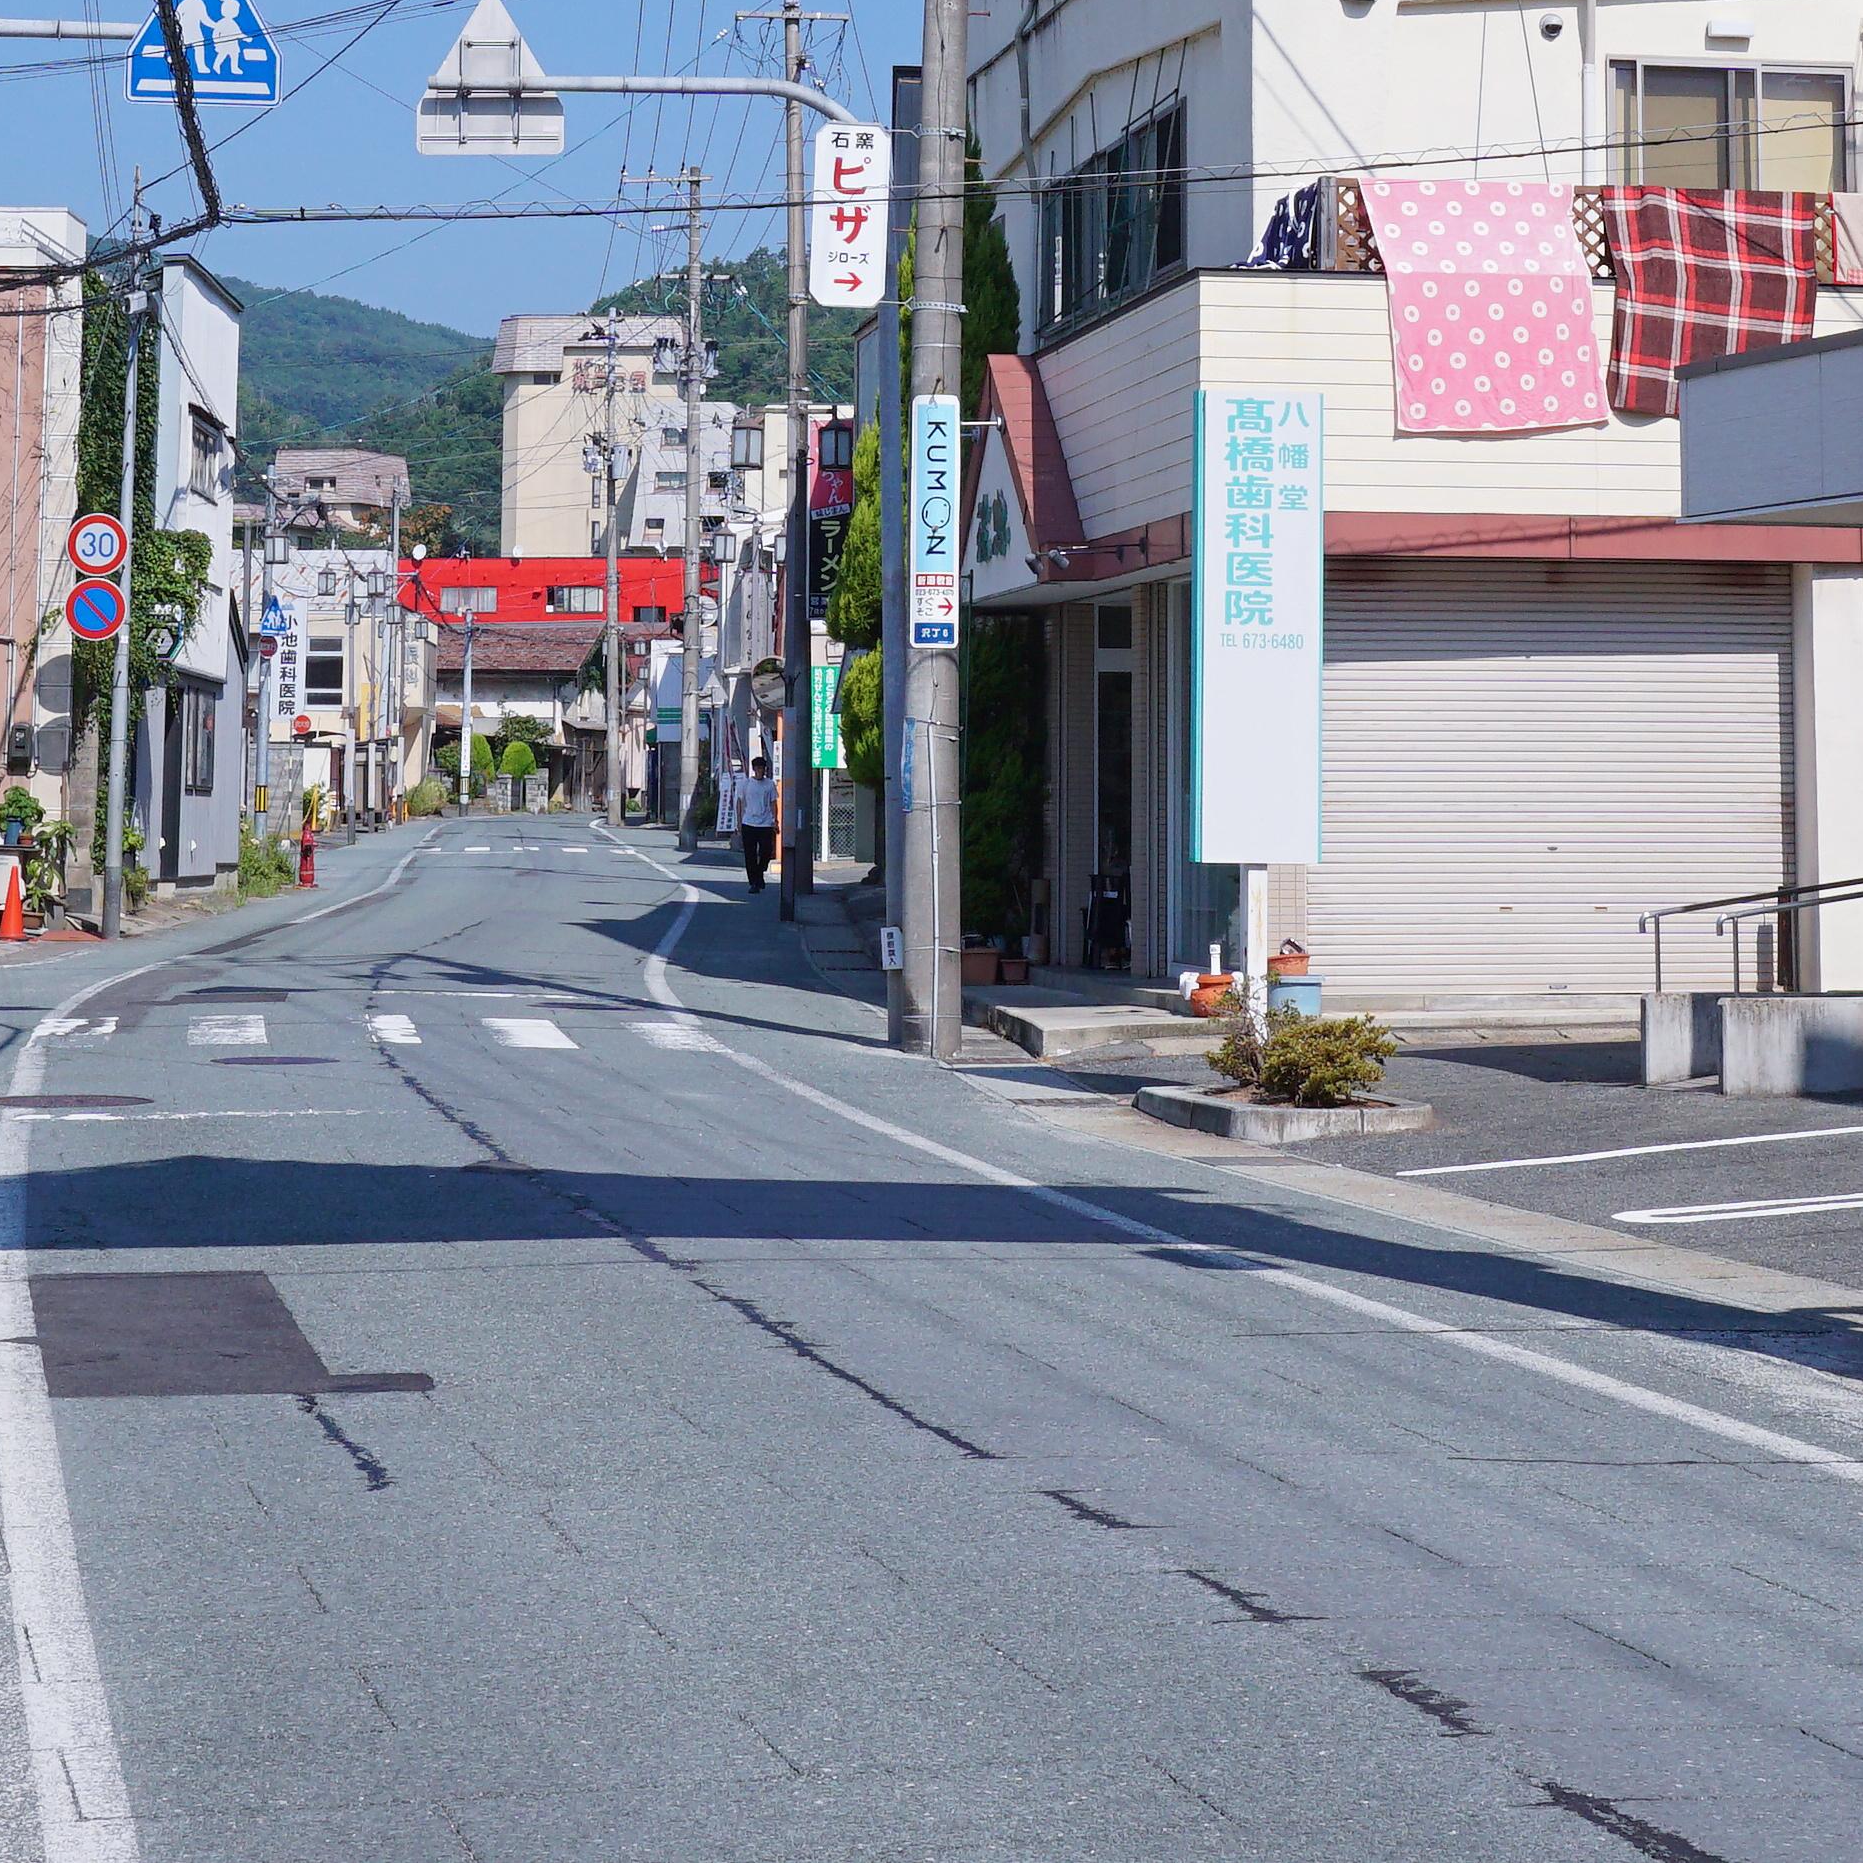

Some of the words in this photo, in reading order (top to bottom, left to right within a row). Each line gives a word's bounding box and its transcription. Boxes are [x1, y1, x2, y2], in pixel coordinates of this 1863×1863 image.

[831, 131, 874, 150] 石窯
[829, 156, 872, 244] ピザ
[828, 251, 870, 264] ジローズ
[1277, 401, 1310, 511] 八幡堂
[921, 420, 952, 557] KUMON
[81, 532, 115, 558] 30
[279, 614, 298, 716] 小池歯科医院
[1220, 633, 1238, 648] TEL
